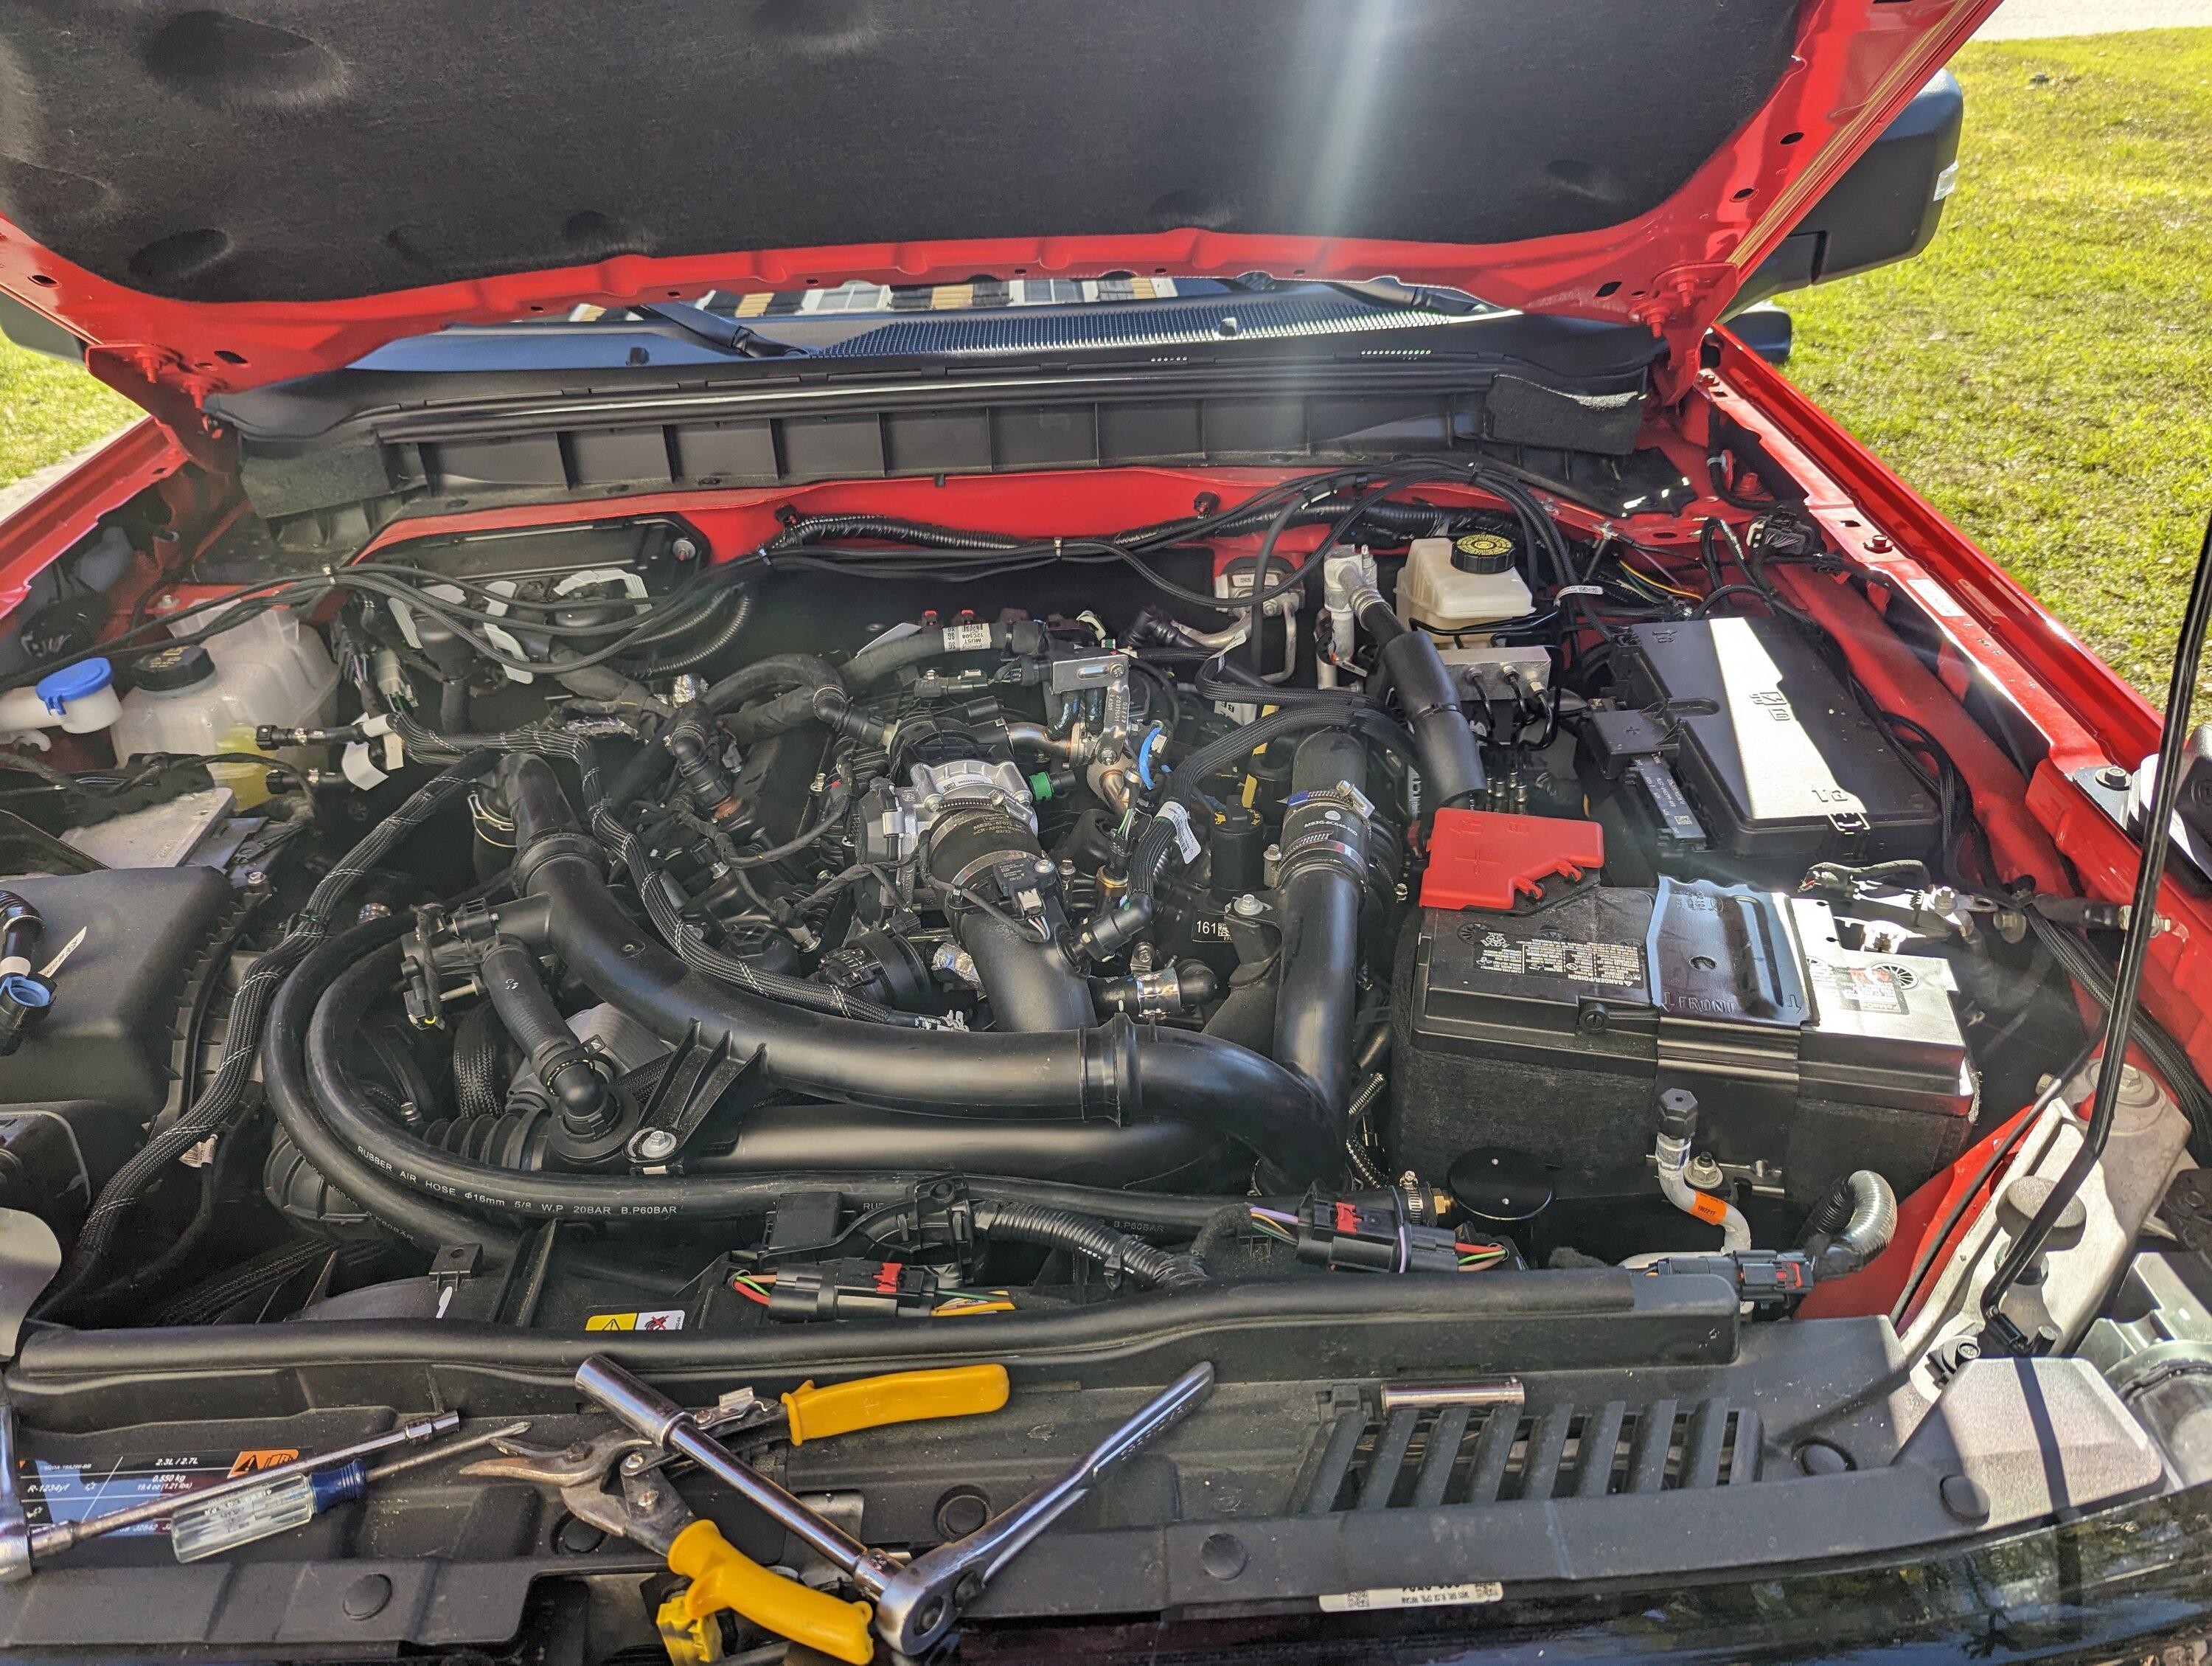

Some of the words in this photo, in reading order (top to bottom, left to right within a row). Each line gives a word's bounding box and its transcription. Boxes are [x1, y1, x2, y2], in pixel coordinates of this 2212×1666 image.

[1197, 920, 1216, 934] 161
[1568, 973, 1624, 985] DANGER/POISON
[1678, 996, 1736, 1013] FRONT
[358, 1145, 392, 1171] RUBBER
[400, 1170, 417, 1182] AIR
[425, 1180, 456, 1196] HOSE
[541, 1204, 563, 1212] W.P
[574, 1206, 611, 1214] 20BAR
[152, 1474, 174, 1482] 0.550
[175, 1474, 186, 1482] kg
[27, 1483, 70, 1493] R-1234yf
